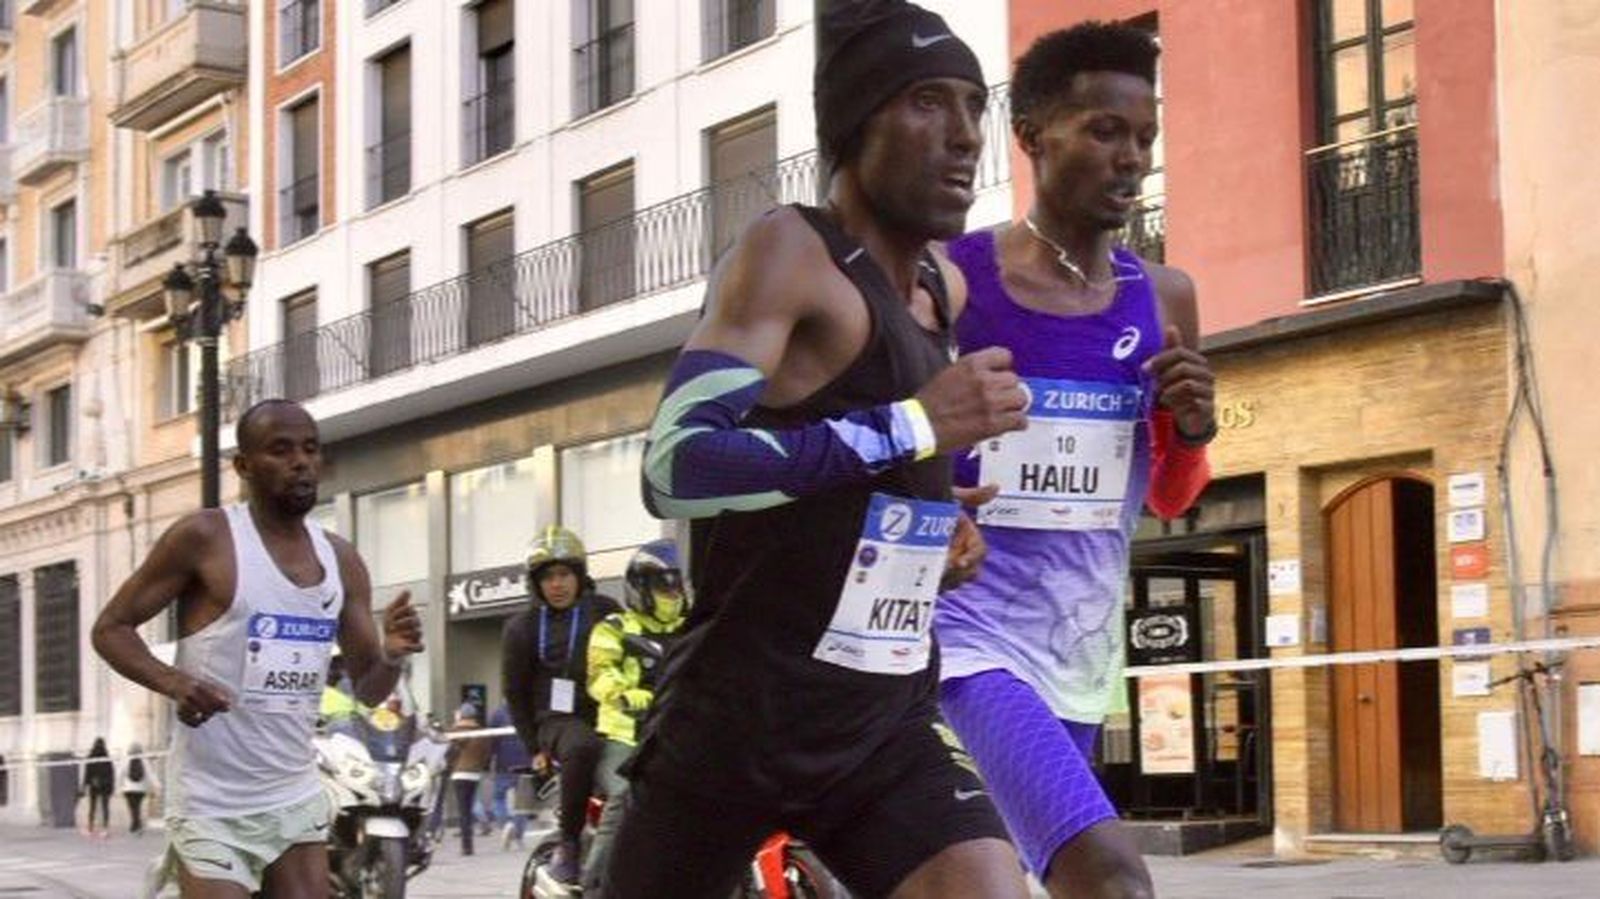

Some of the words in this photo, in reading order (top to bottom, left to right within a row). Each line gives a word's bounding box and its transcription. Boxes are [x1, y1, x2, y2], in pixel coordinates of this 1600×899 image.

[1043, 390, 1122, 412] ZURICH
[1057, 436, 1076, 454] 10
[1020, 463, 1099, 493] HAILU
